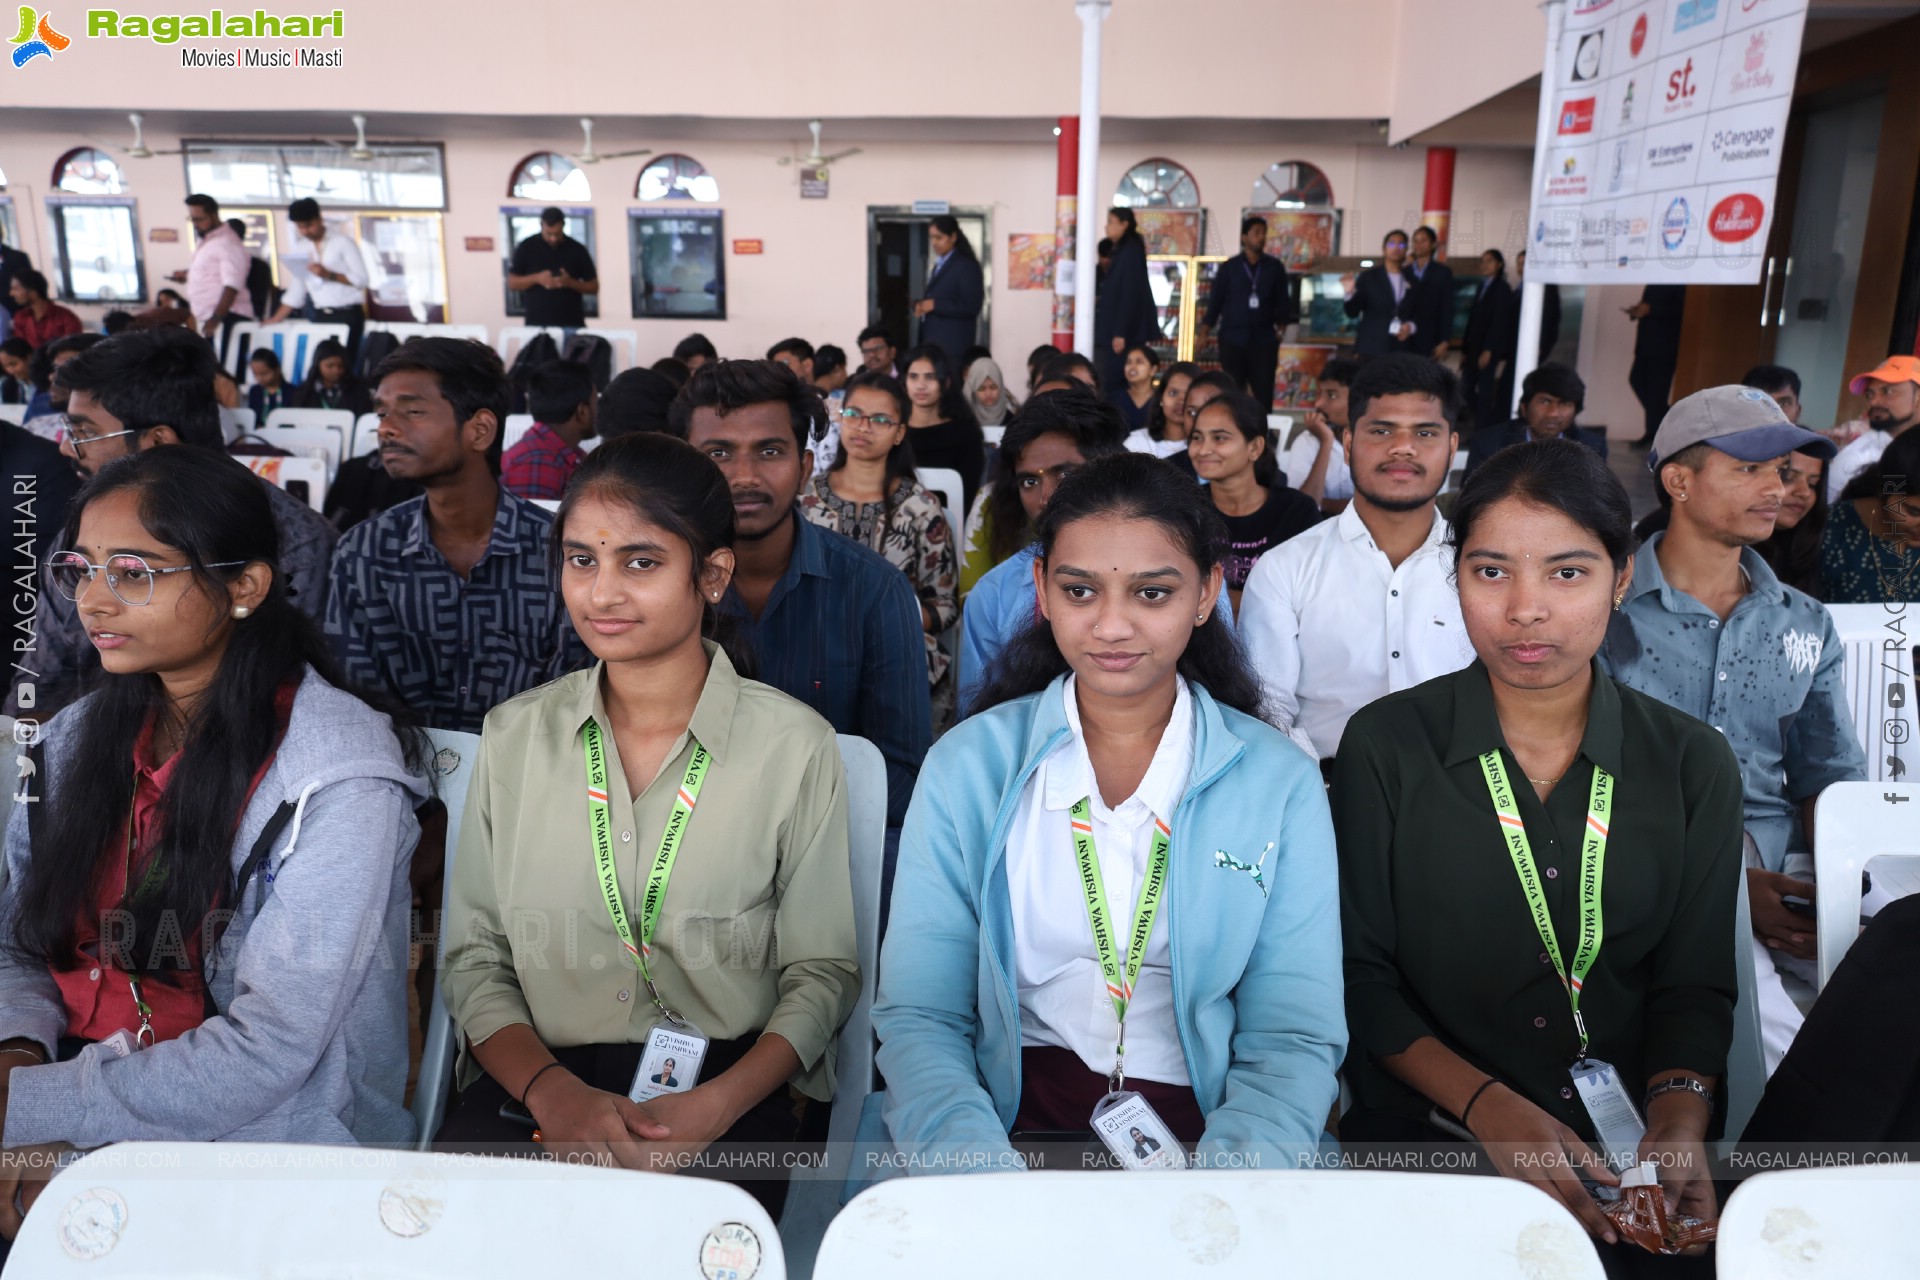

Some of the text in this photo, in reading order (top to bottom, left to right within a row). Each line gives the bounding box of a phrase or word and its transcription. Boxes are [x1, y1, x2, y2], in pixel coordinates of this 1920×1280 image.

[1721, 148, 1770, 163] Publications
[1724, 127, 1774, 147] Cengage
[588, 721, 600, 771] VISHWA
[595, 808, 622, 924] VISHWA VISHWANI
[643, 810, 685, 922] VISHWA VISHWANI
[1078, 839, 1110, 961] VISHWA VISHWANI
[1131, 841, 1168, 961] VISHWA VISHWANI
[1511, 835, 1555, 955] VISHWA VISHWANI
[1579, 839, 1598, 959] VISHWA VISHWANI
[668, 1044, 699, 1056] VISHWANI
[670, 1037, 695, 1048] VISHWA
[1113, 1105, 1137, 1120] VISHWA
[1118, 1108, 1146, 1126] VISHWANI
